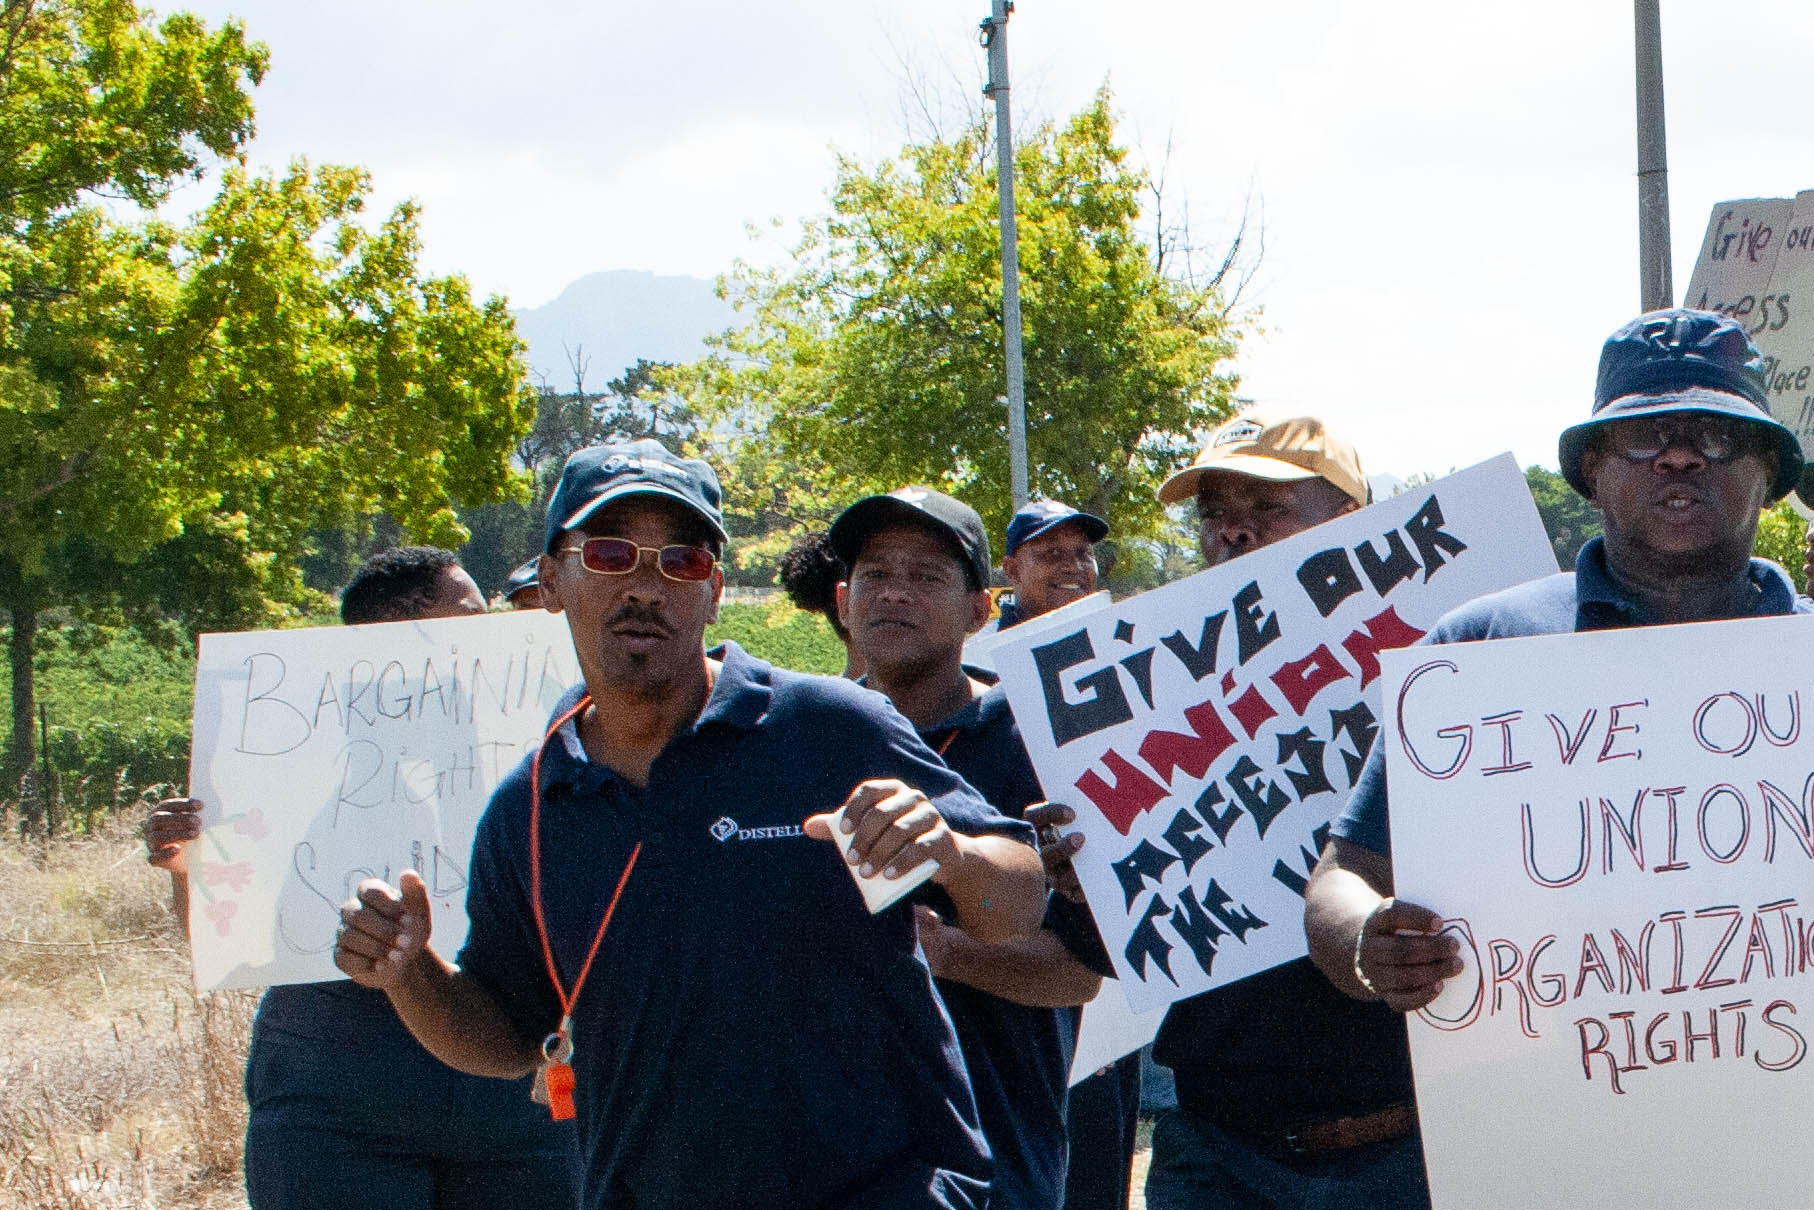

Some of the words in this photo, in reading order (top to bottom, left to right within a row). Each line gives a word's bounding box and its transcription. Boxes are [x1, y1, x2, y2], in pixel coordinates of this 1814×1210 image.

[1397, 660, 1648, 779] GIVE
[738, 825, 804, 840] DISTELL
[1574, 1000, 1807, 1094] RIGHTS
